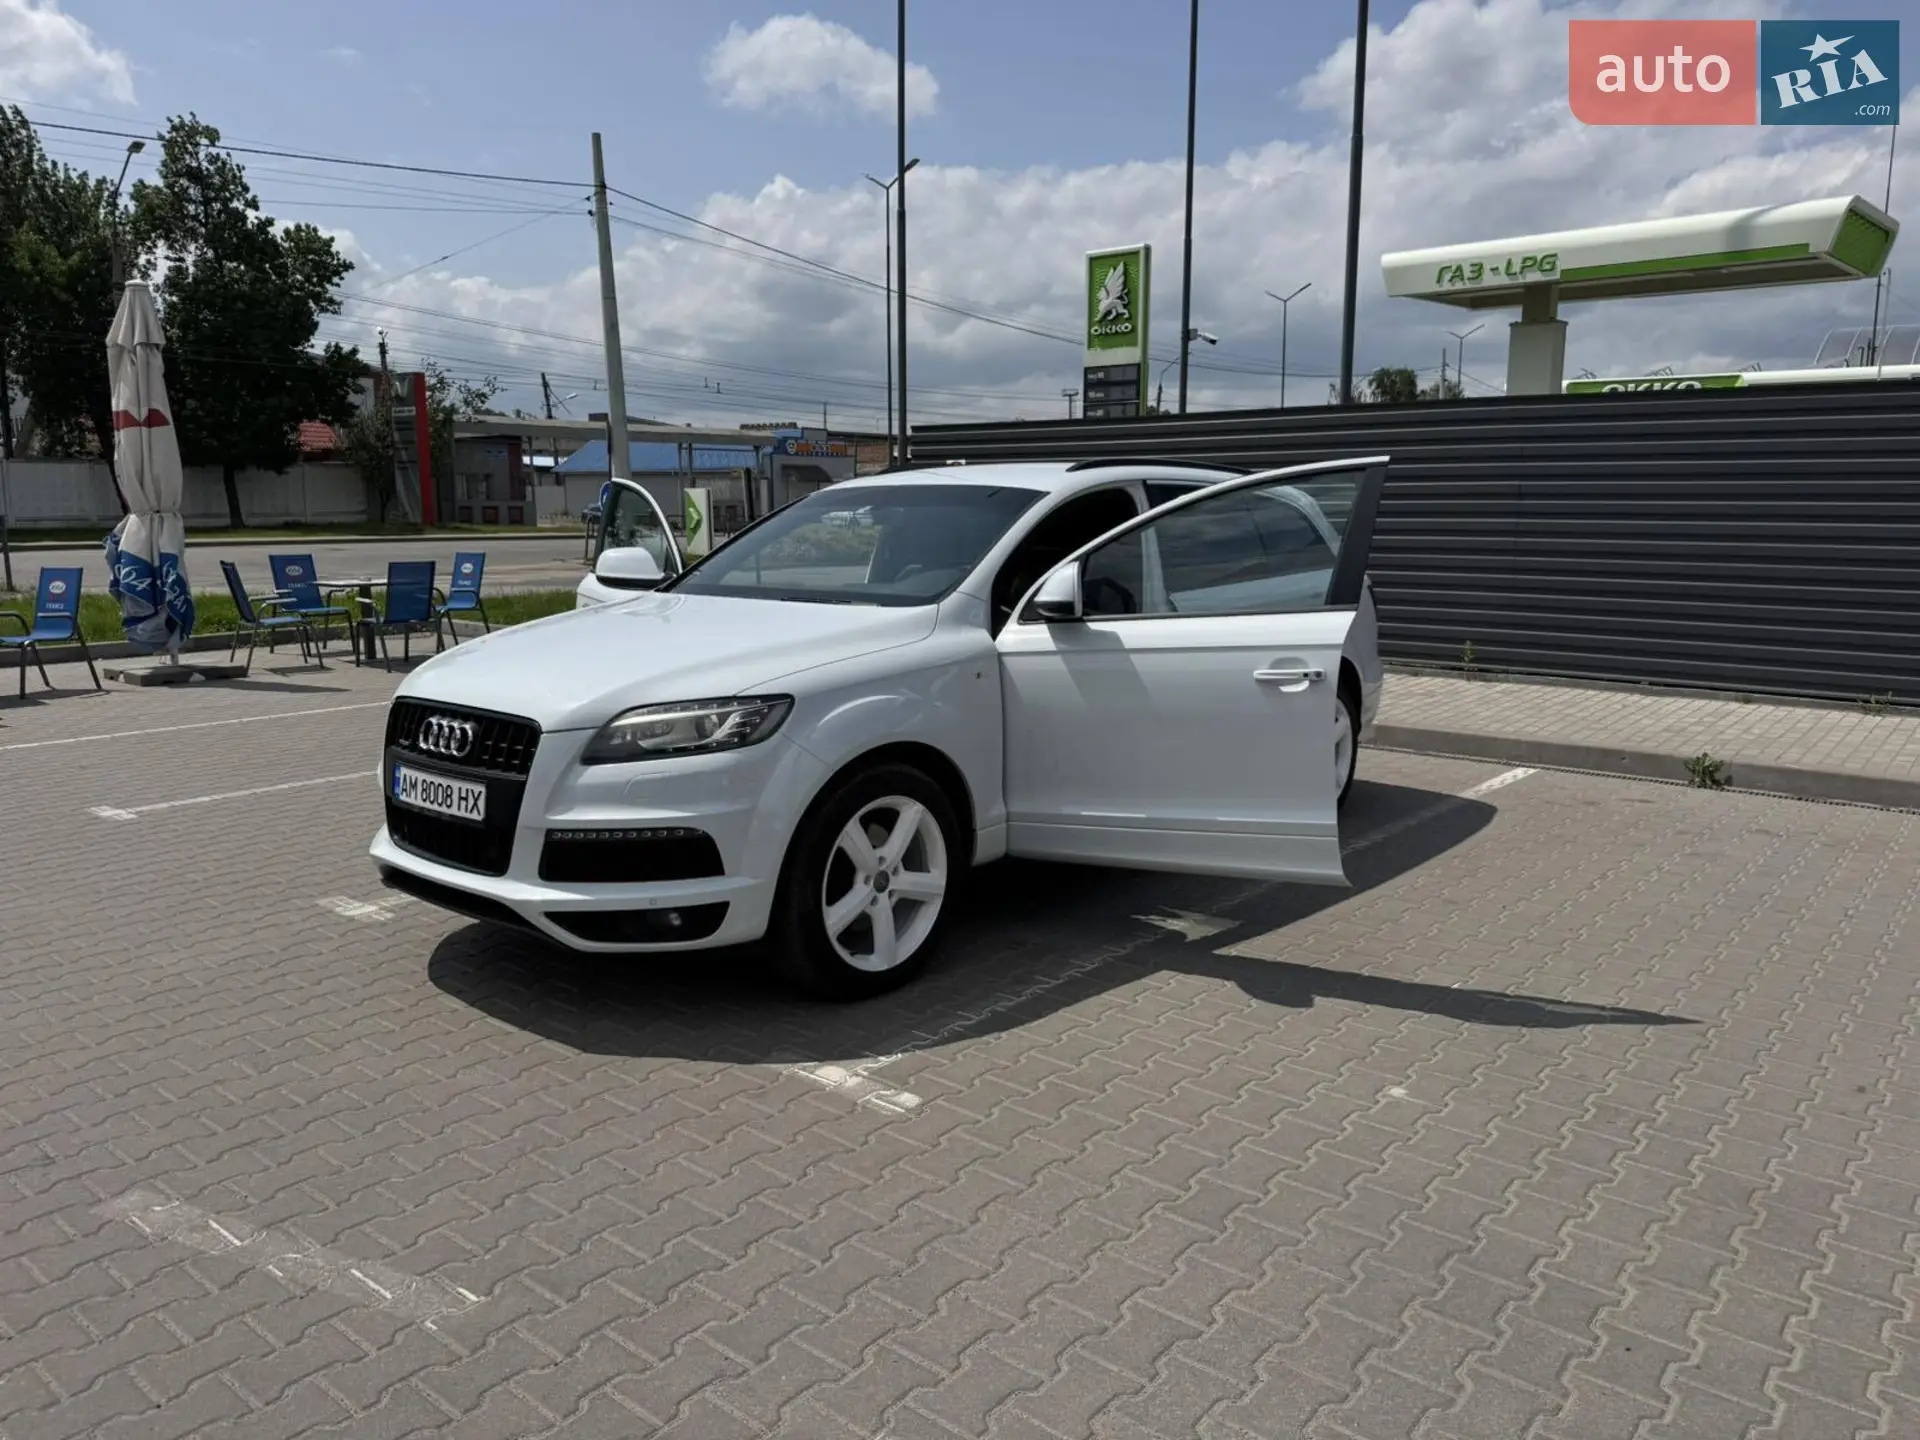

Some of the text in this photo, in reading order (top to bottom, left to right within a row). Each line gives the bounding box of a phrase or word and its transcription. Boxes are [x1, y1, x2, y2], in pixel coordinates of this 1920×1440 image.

[1090, 322, 1132, 335] OKKO
[401, 773, 482, 816] AM 8008 HX
